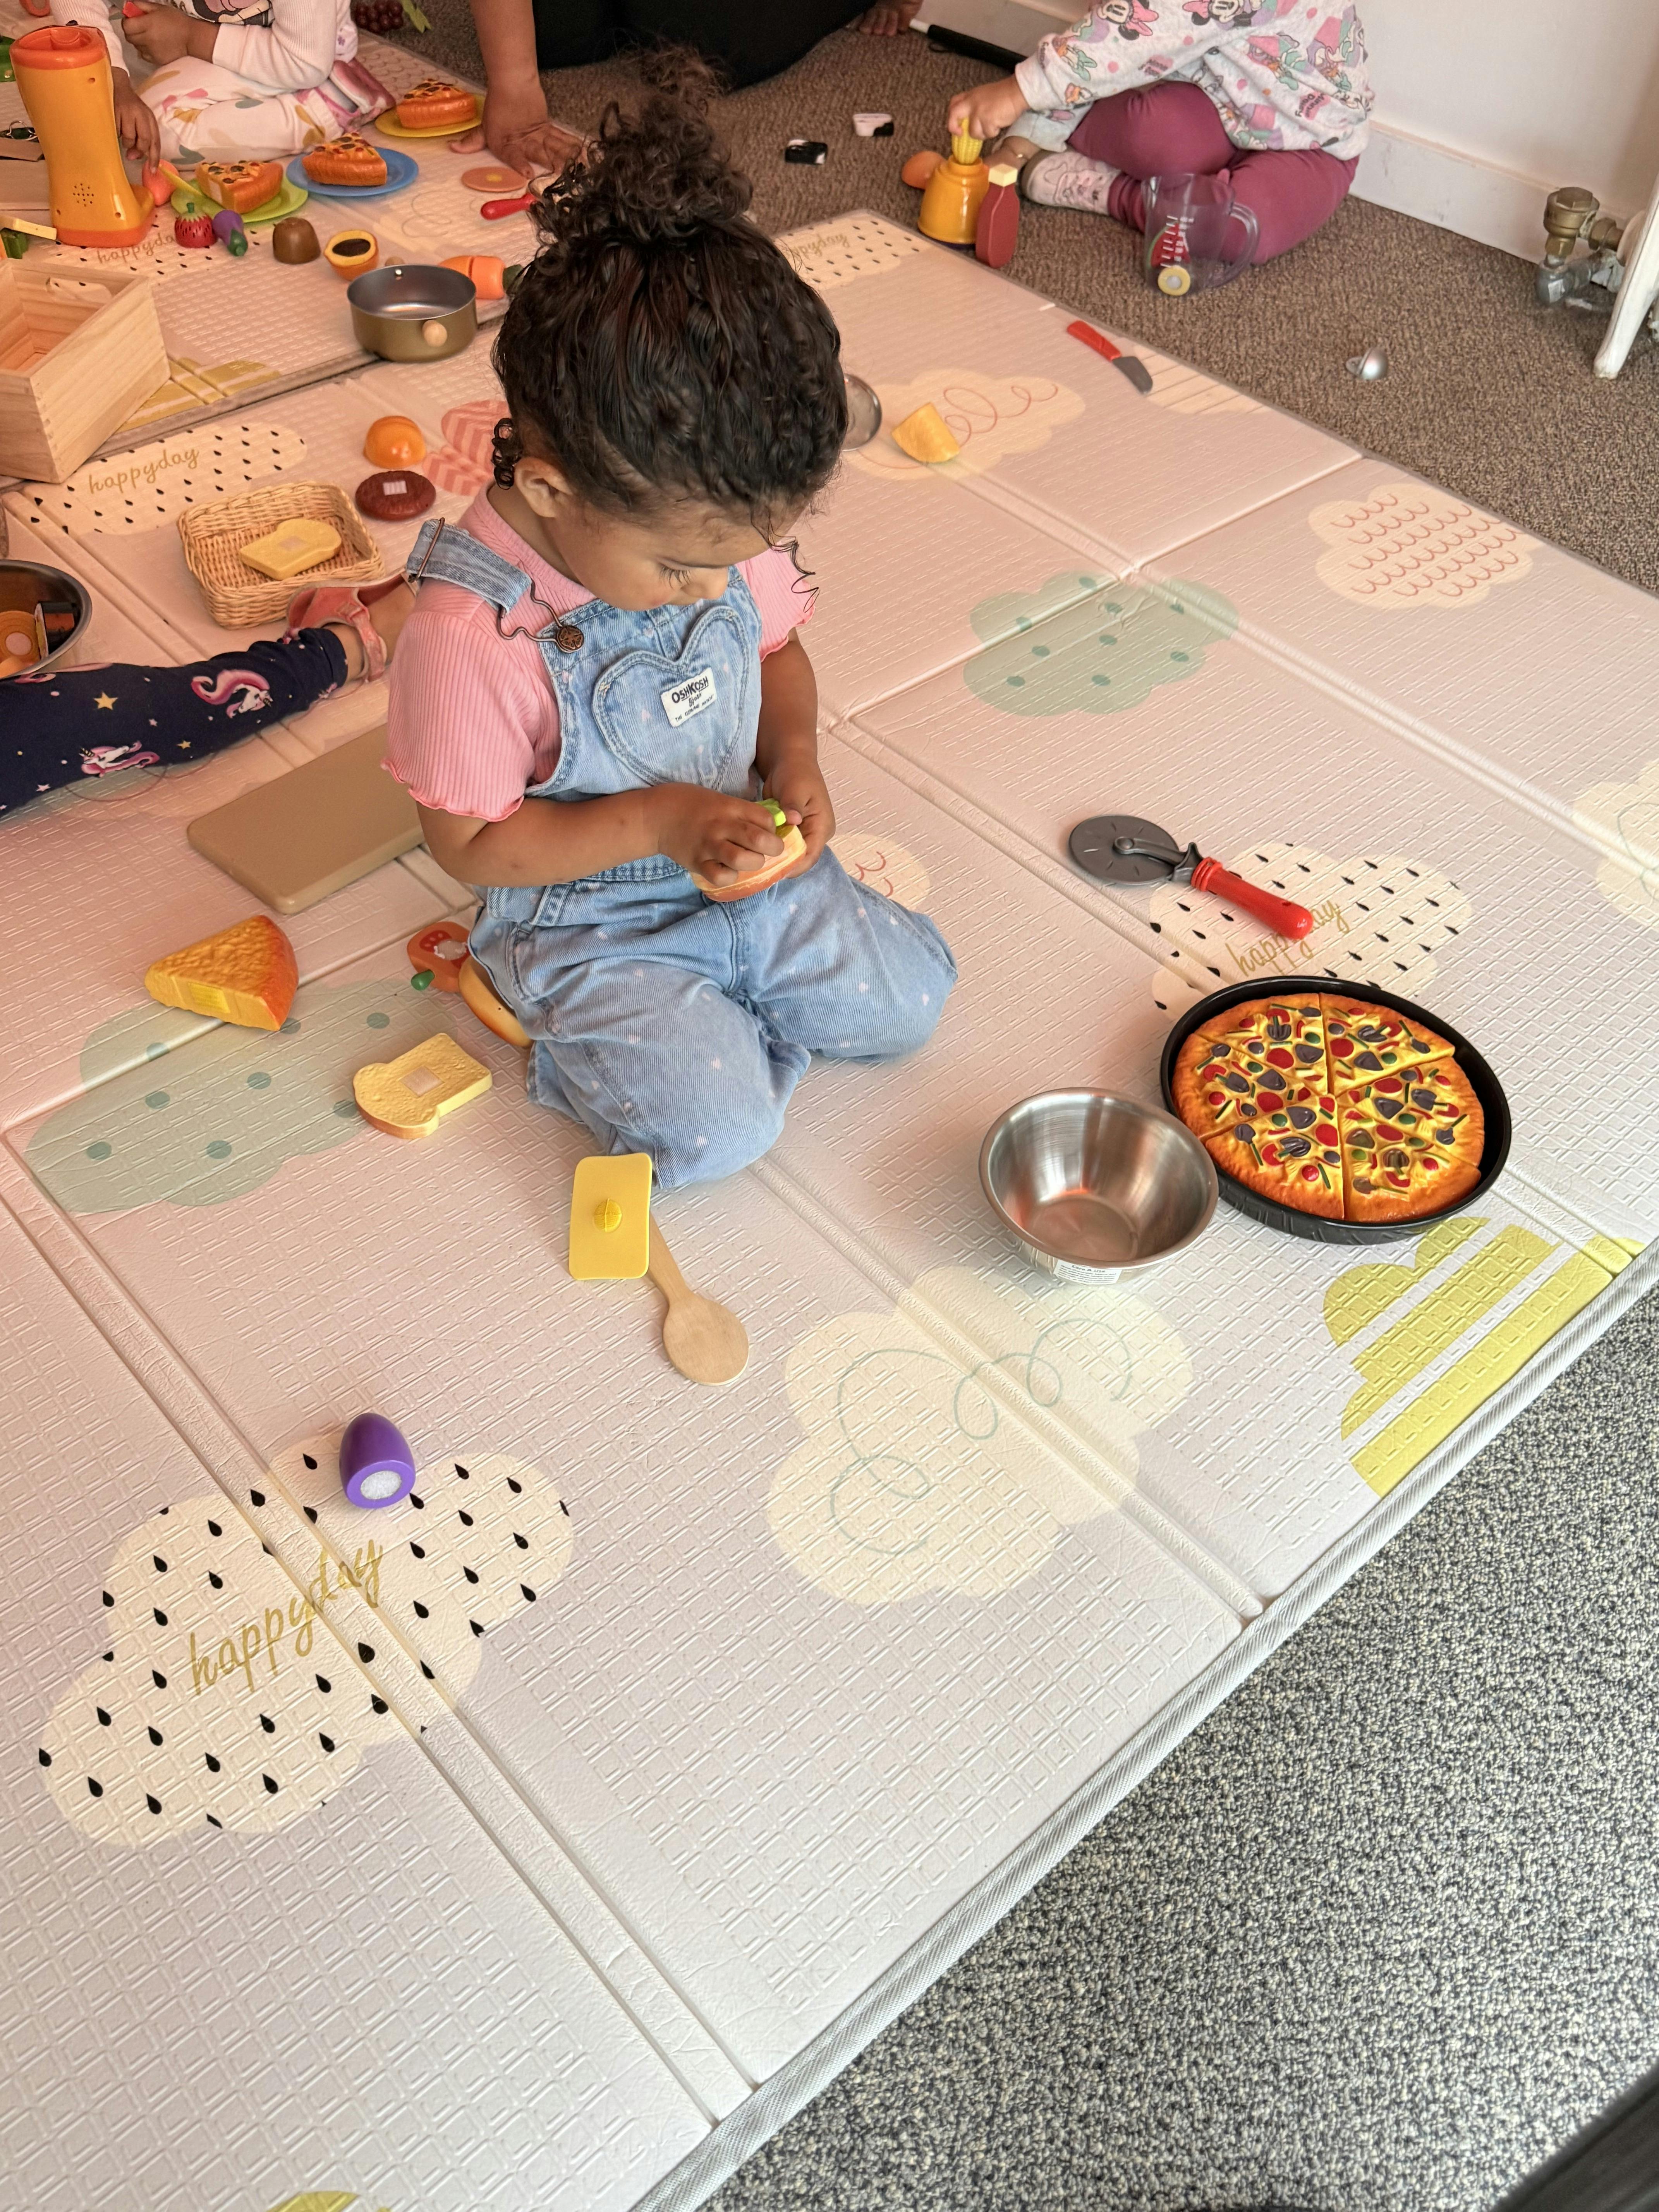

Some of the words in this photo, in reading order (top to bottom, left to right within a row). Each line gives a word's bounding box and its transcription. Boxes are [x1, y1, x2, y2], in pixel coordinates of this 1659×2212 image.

[97, 232, 174, 264] happyda
[89, 448, 200, 494] happyday
[189, 1539, 383, 1696] happyday
